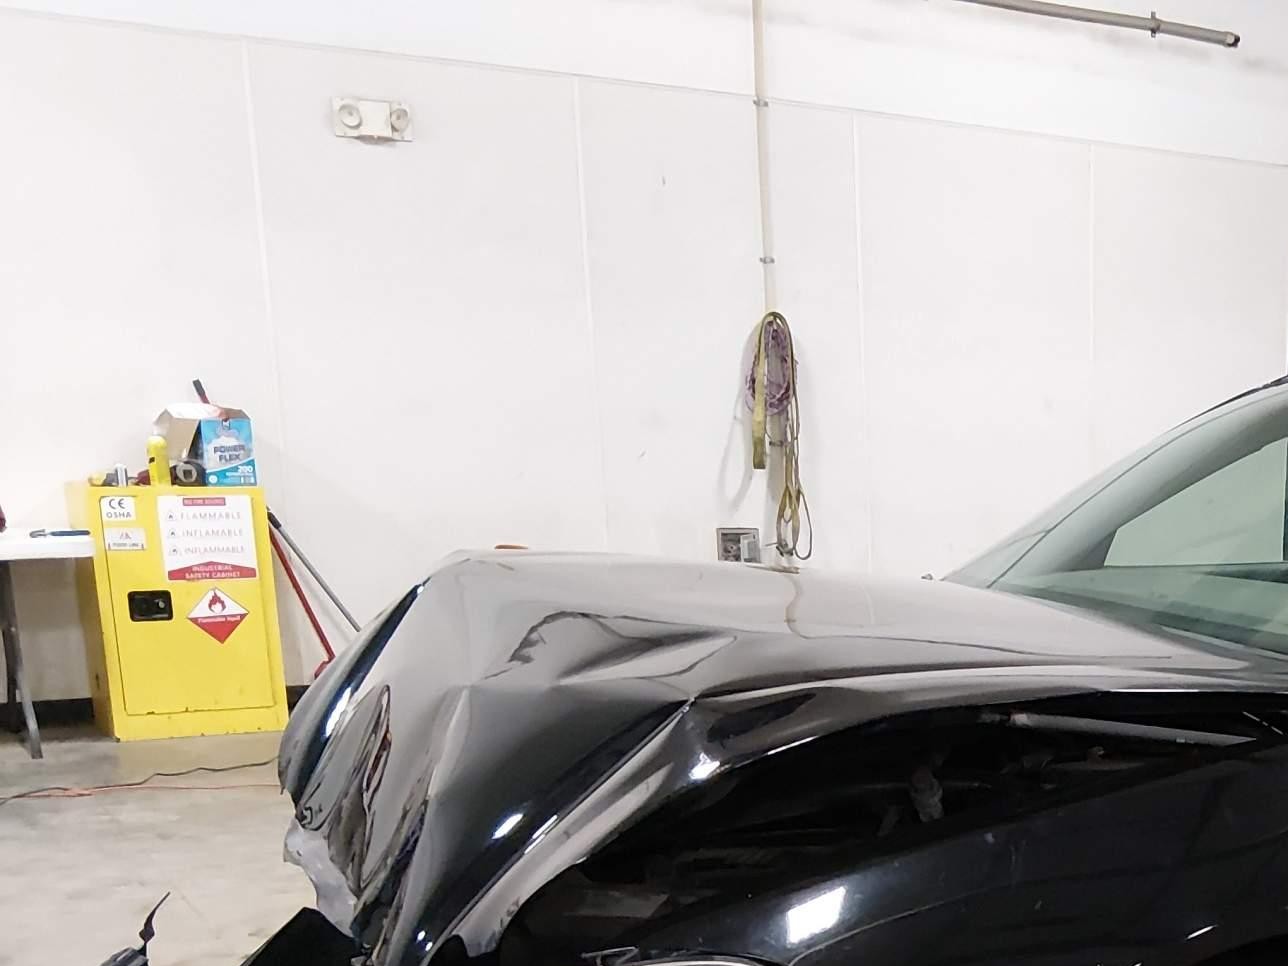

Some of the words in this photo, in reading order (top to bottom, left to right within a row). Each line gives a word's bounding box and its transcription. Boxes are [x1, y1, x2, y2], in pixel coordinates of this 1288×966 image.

[213, 444, 246, 455] POWER
[218, 454, 241, 463] FLEX
[106, 511, 132, 519] OSHA
[180, 511, 242, 520] FLAMMABLE
